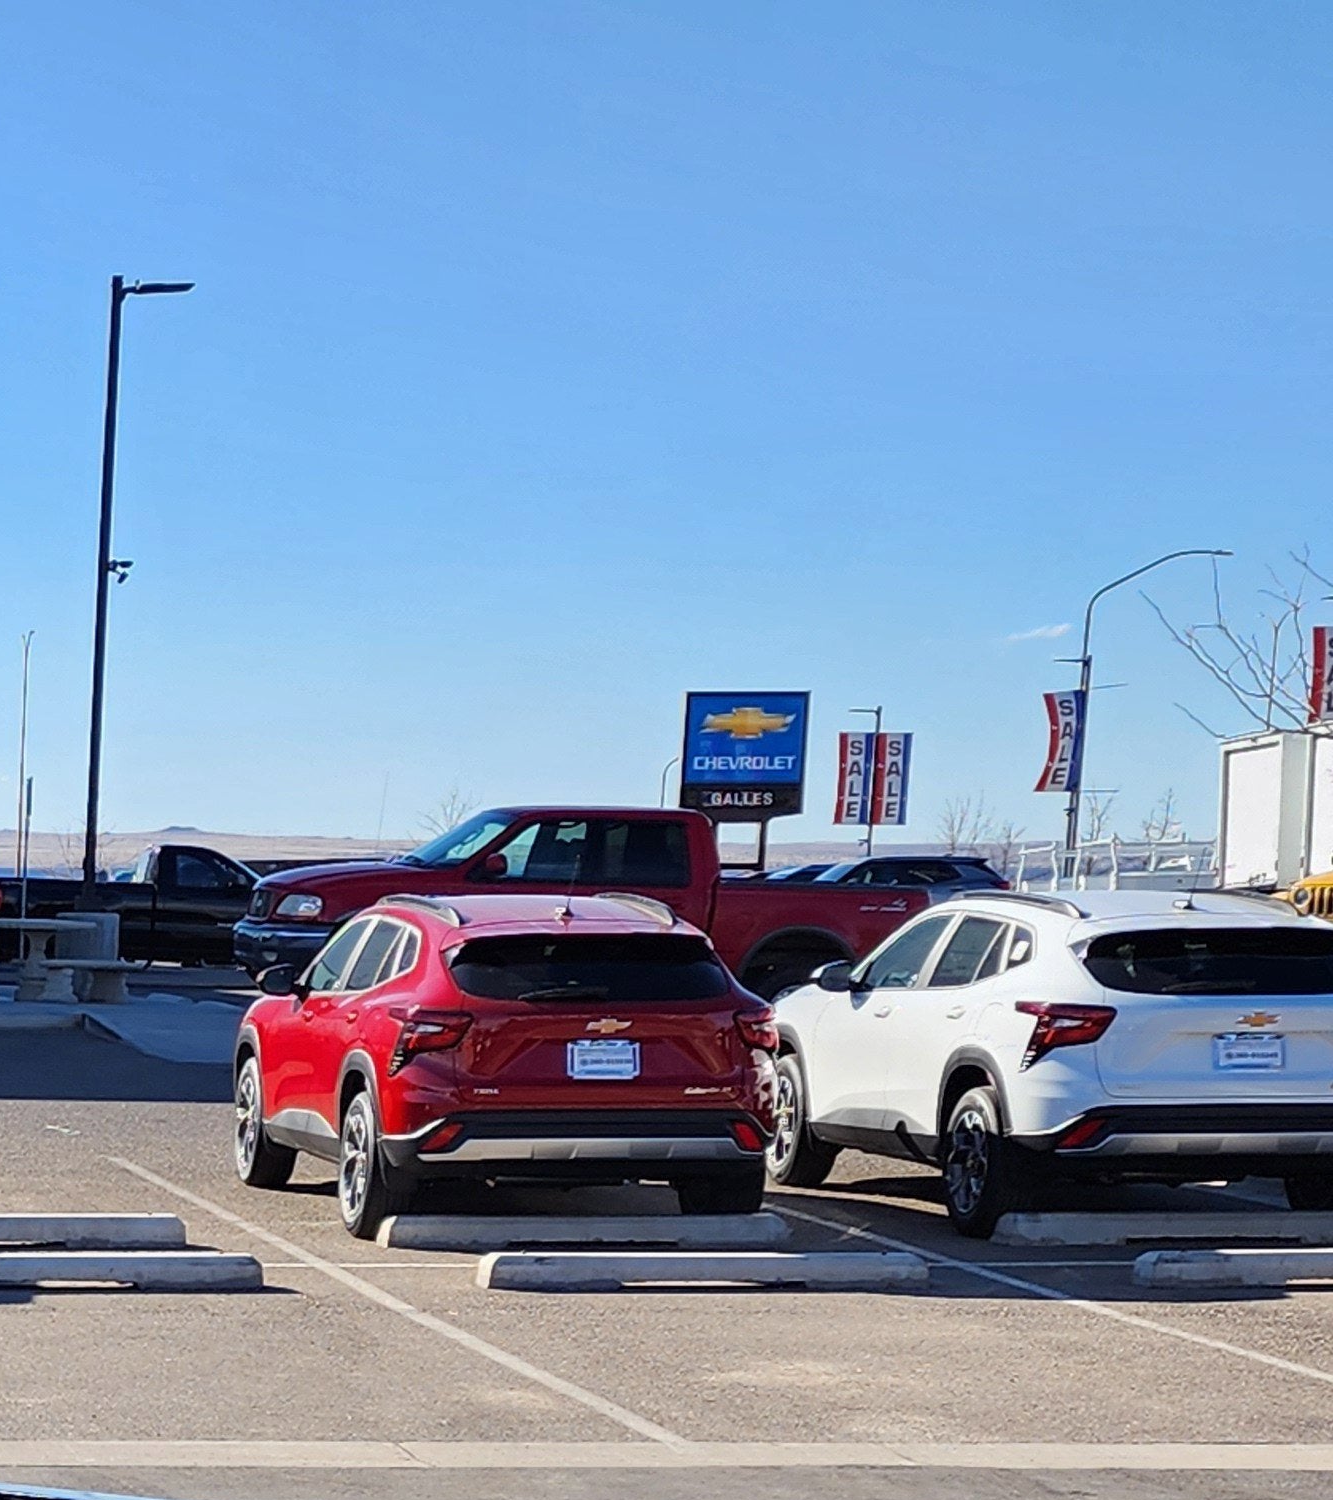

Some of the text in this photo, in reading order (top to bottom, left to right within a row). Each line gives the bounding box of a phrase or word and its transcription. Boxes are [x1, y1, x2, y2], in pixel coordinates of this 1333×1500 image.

[693, 756, 797, 770] CHEVROLET
[845, 740, 863, 818] SALE
[886, 740, 901, 818] SALE
[1050, 698, 1074, 784] SALE
[711, 791, 773, 806] GALLES
